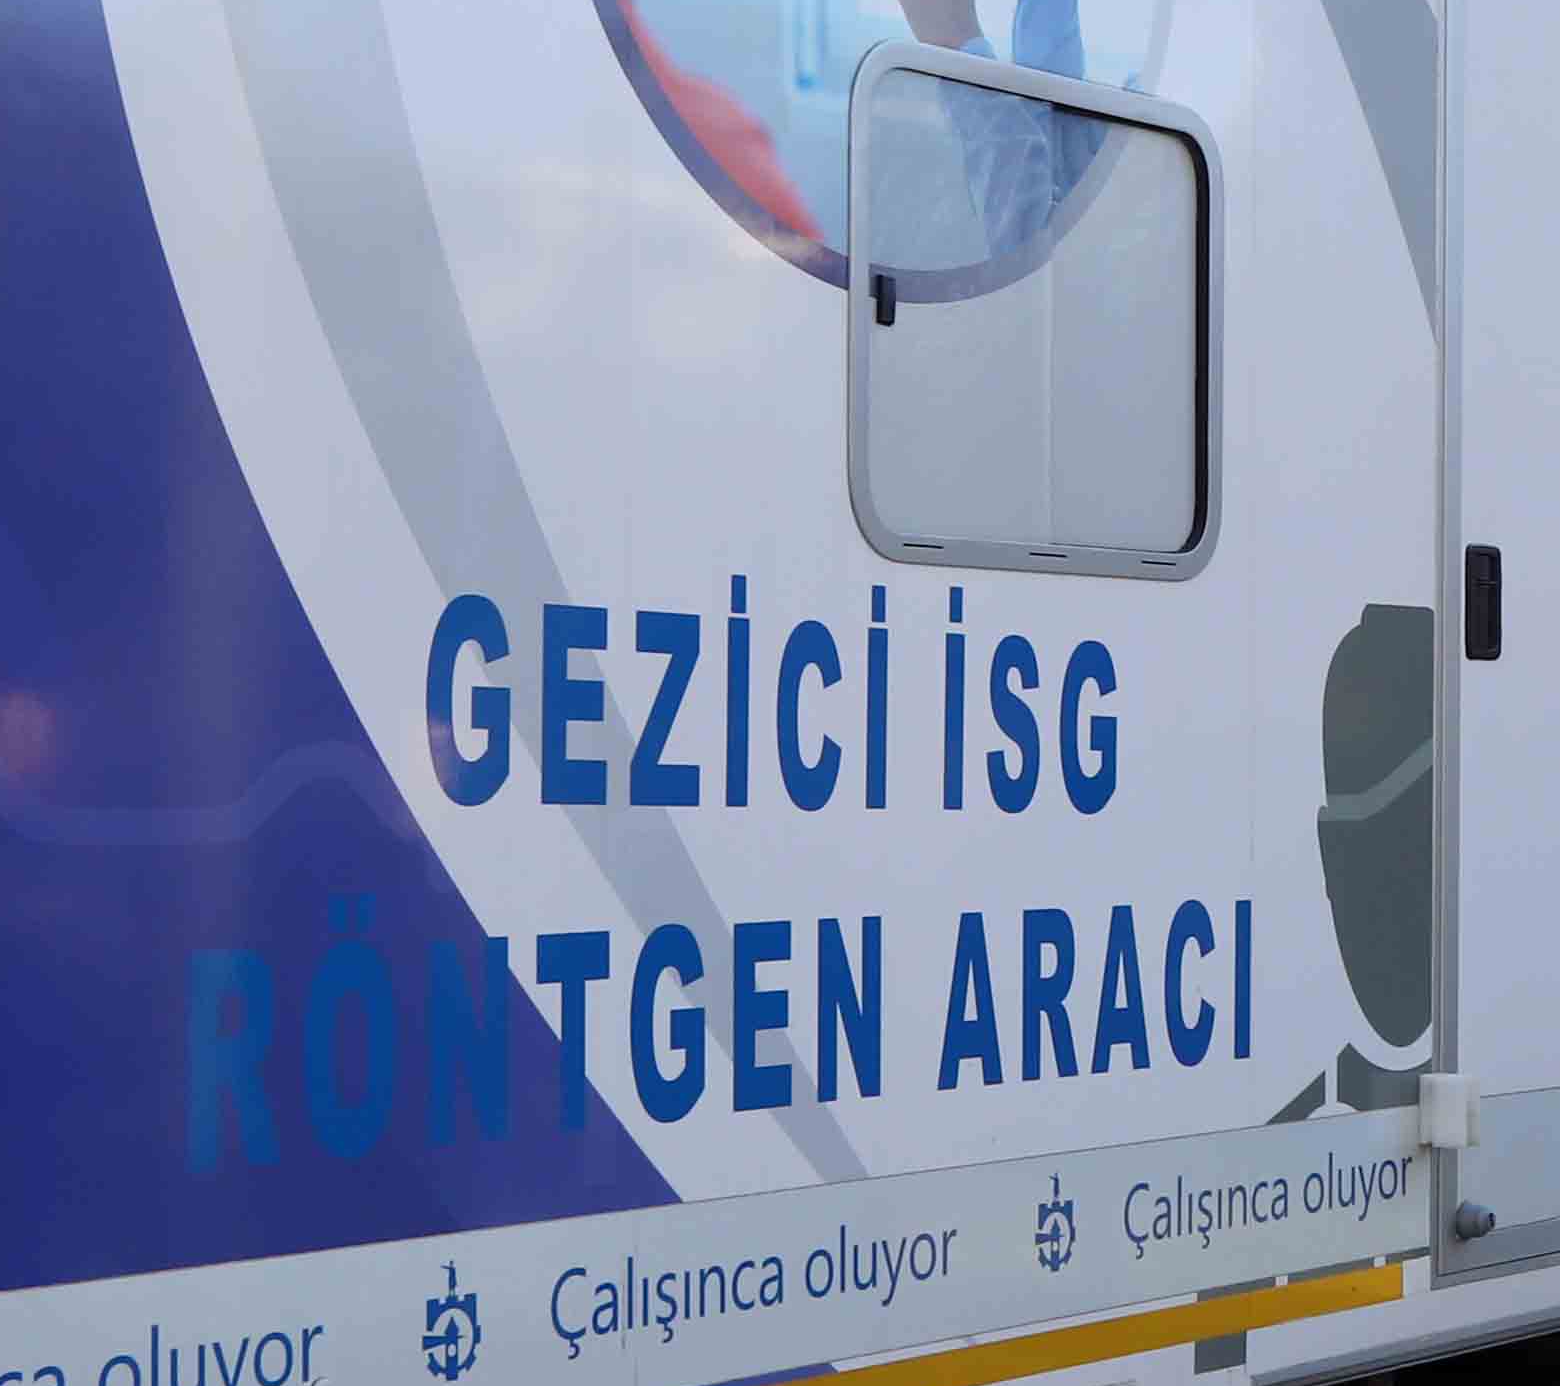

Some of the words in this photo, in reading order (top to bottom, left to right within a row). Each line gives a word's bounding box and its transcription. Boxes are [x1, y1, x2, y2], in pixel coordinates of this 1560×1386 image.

[425, 574, 888, 812] GEZİCİ
[941, 586, 1119, 815] İSG
[185, 892, 882, 1174] RÖNTGEN
[936, 898, 1254, 1091] ARACI
[549, 1255, 785, 1361] Çalışınca
[804, 1224, 959, 1308] oluyor
[1123, 1174, 1290, 1260] Çalışınca
[1302, 1151, 1414, 1222] oluyor
